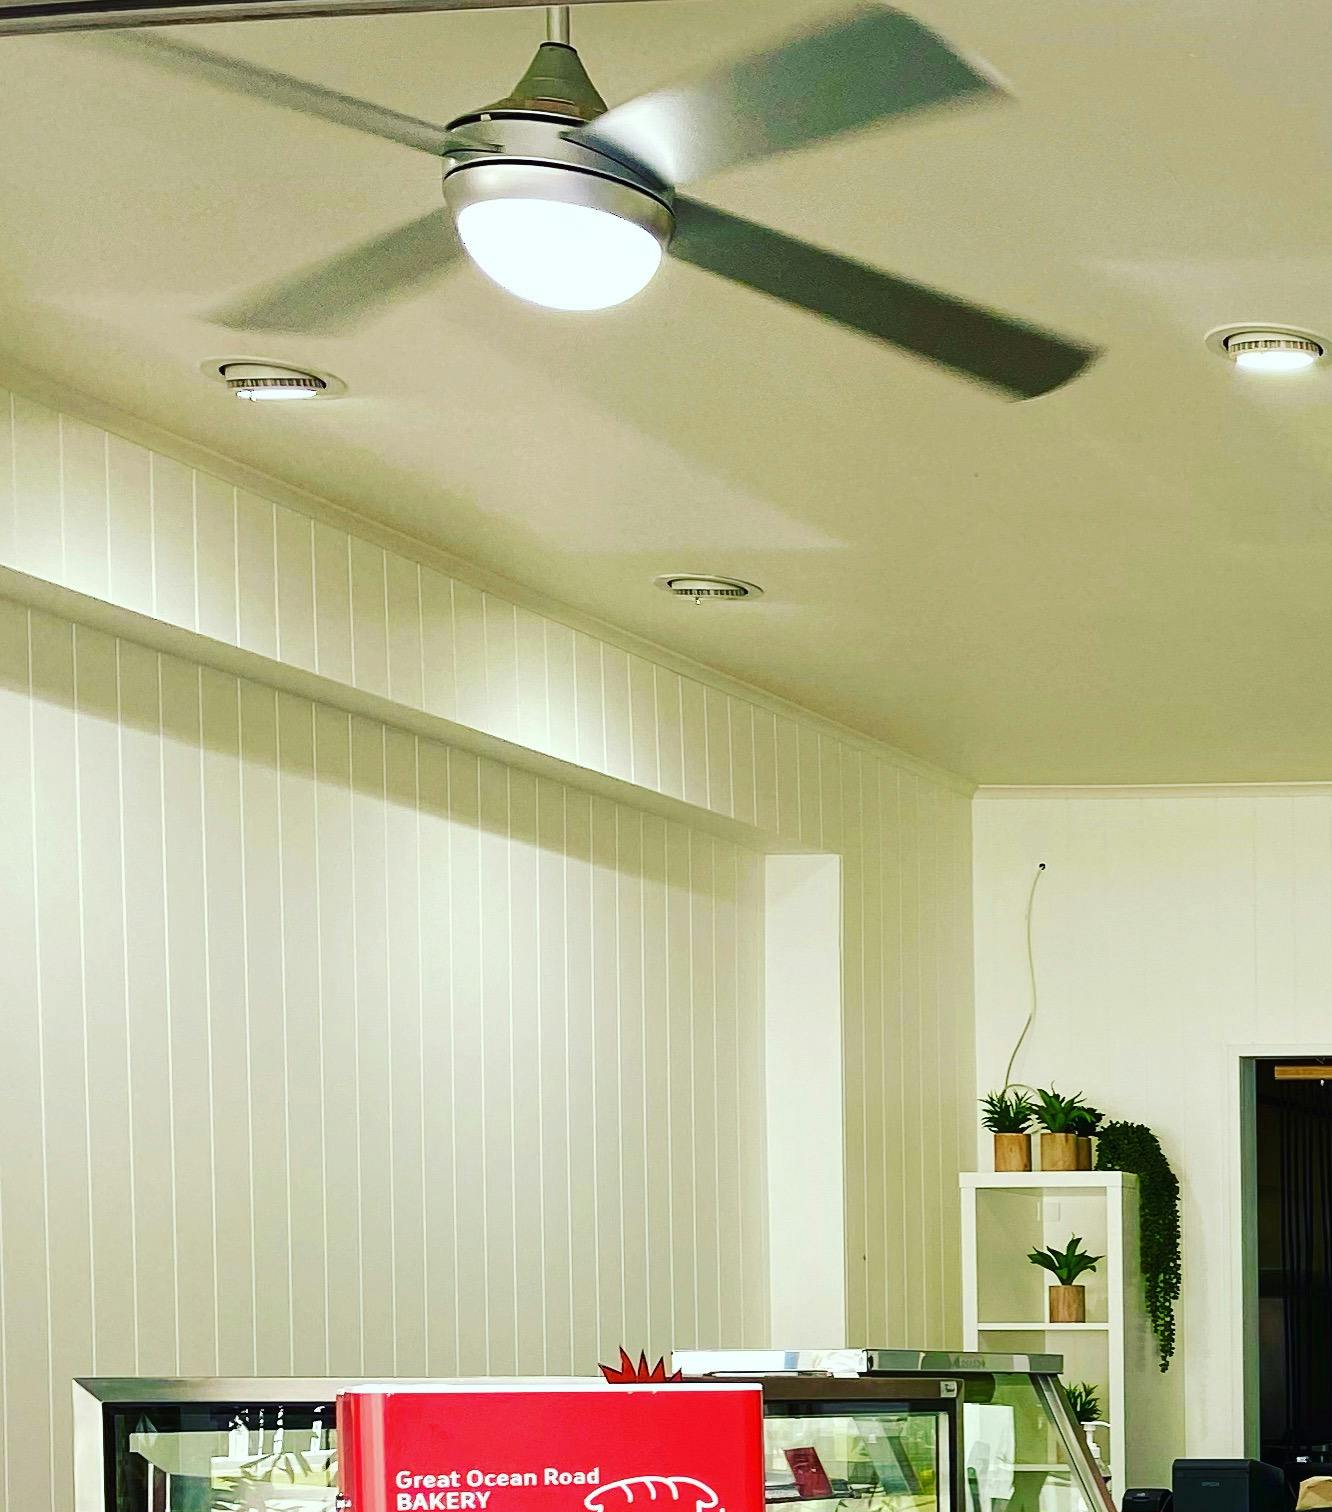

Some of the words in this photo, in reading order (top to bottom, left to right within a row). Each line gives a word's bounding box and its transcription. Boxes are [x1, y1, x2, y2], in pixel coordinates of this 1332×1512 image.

[396, 1470, 461, 1489] Great
[466, 1469, 537, 1488] Ocean
[544, 1467, 600, 1486] Road
[397, 1491, 491, 1512] BAKERY
